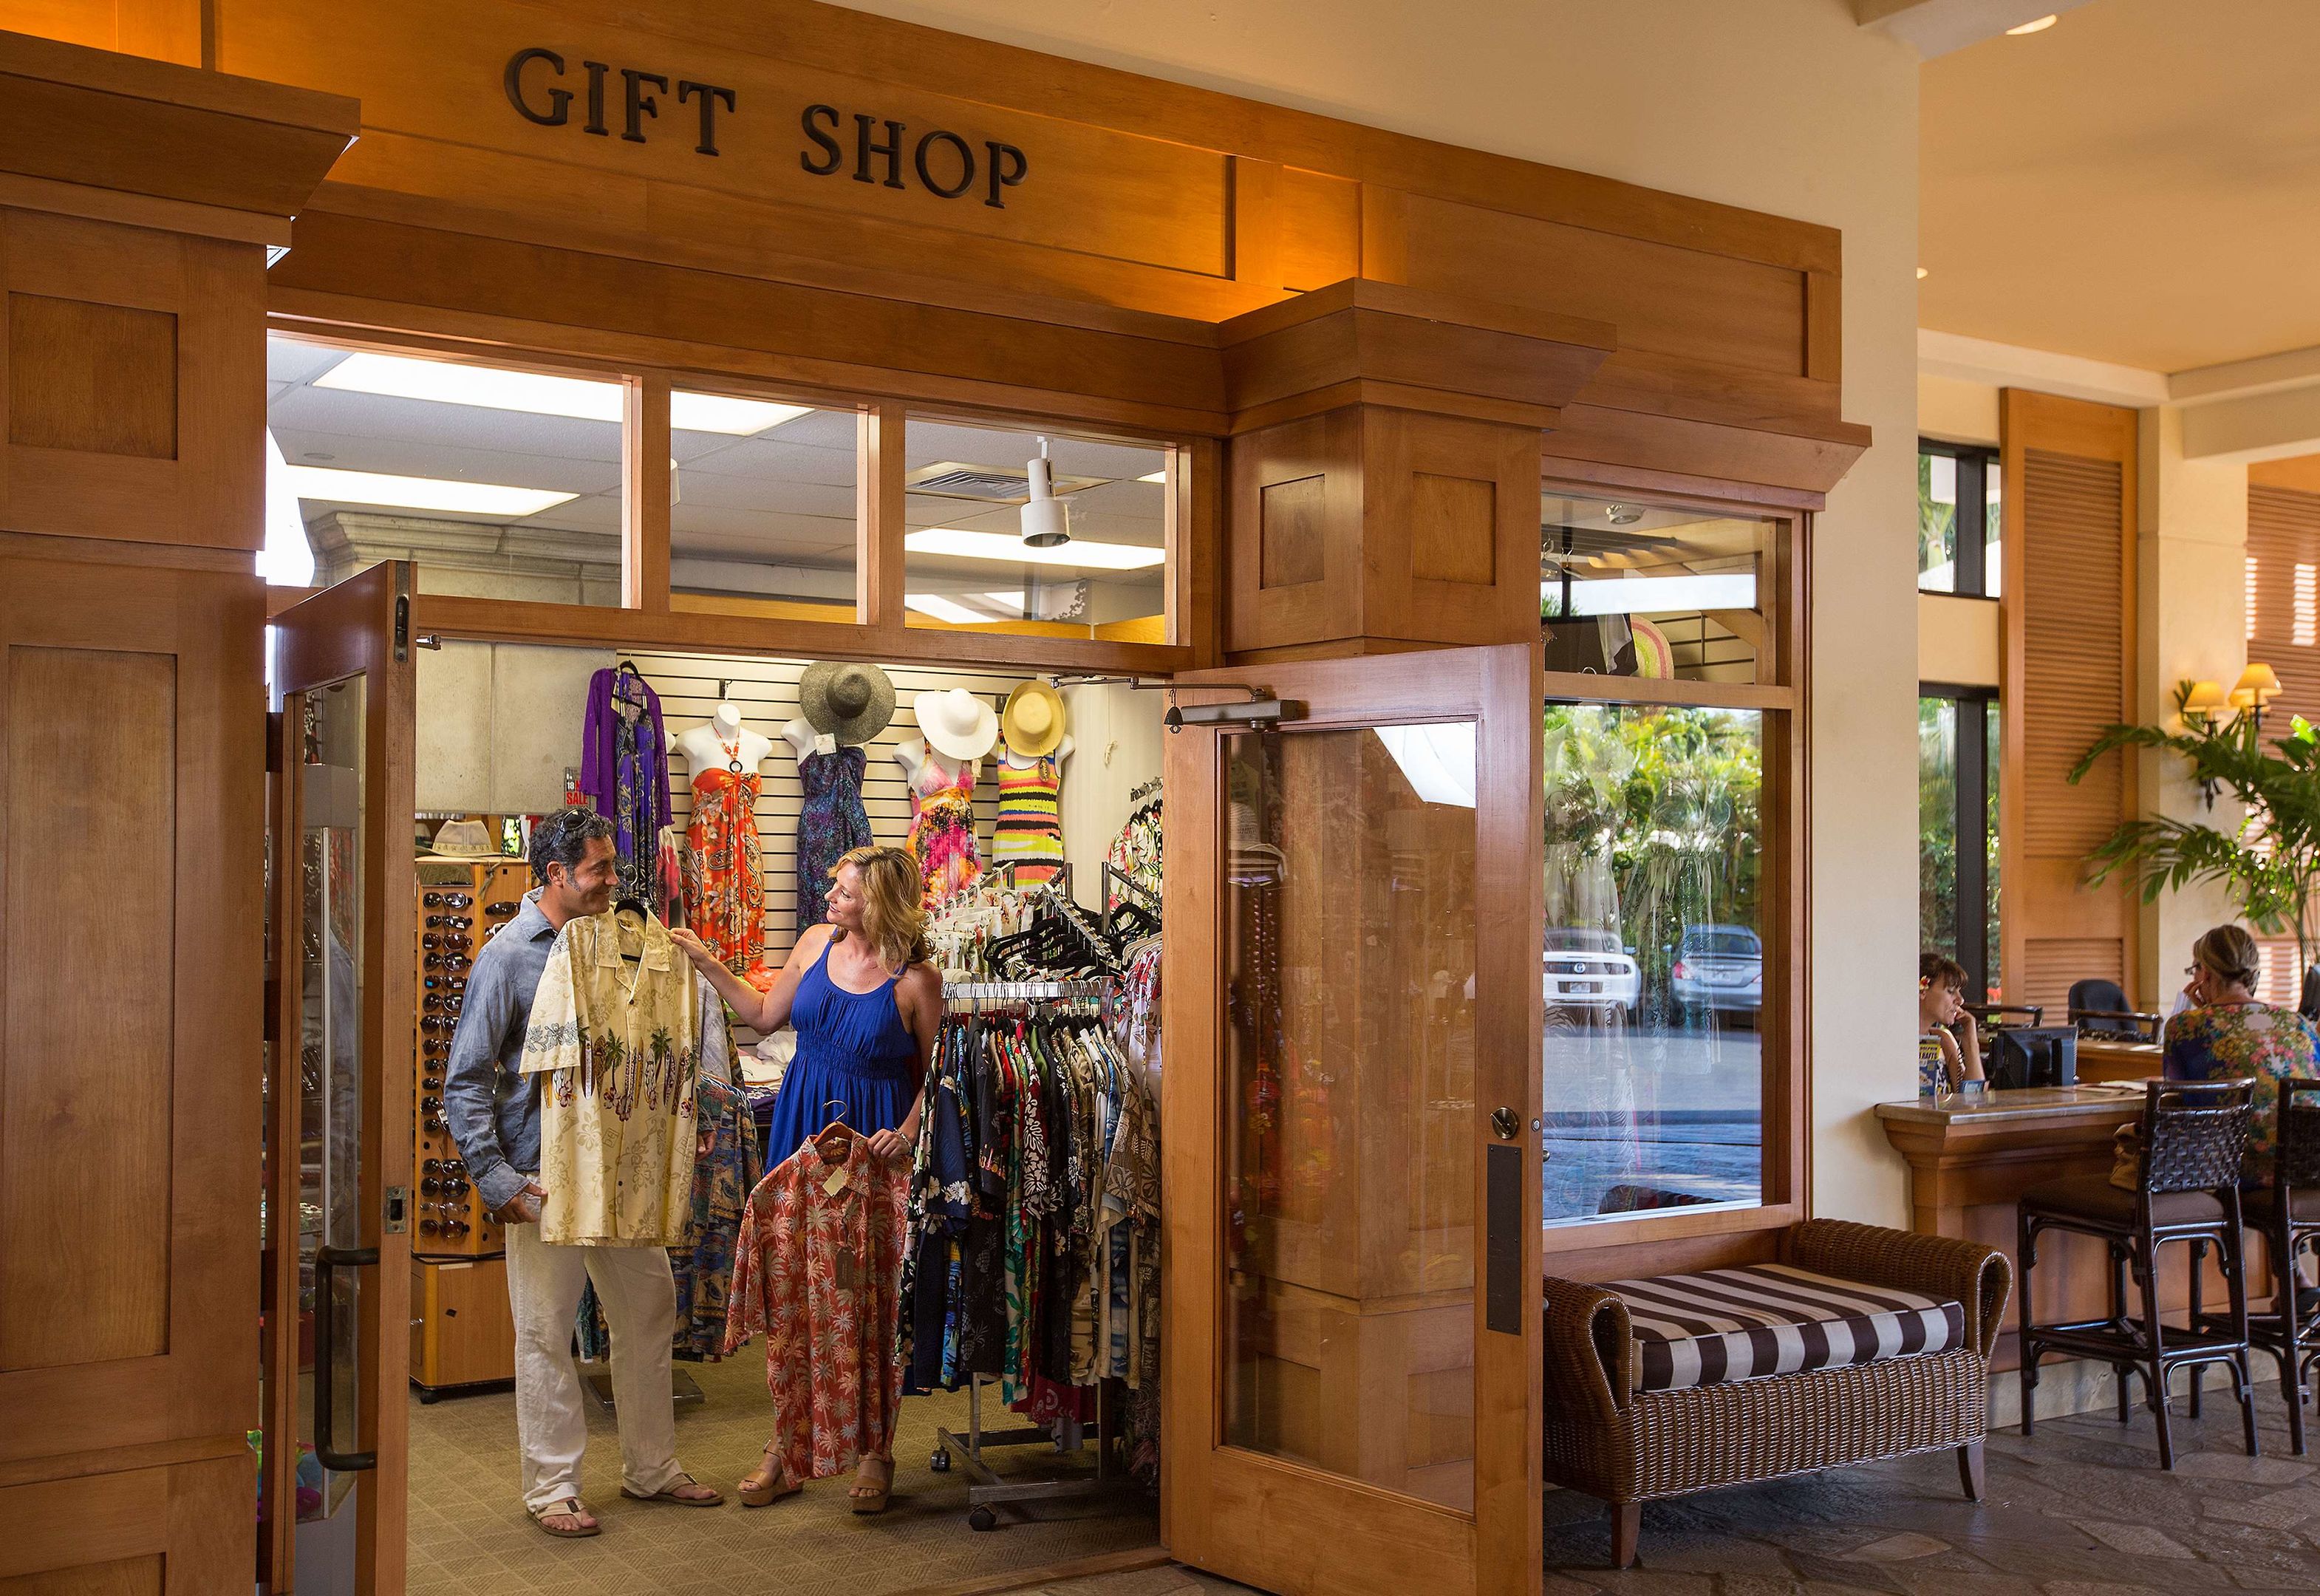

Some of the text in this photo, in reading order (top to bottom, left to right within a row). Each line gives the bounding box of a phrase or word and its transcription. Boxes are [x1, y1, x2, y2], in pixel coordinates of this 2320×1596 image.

[504, 47, 1028, 209] GIFT SHOP
[566, 791, 588, 805] SALE
